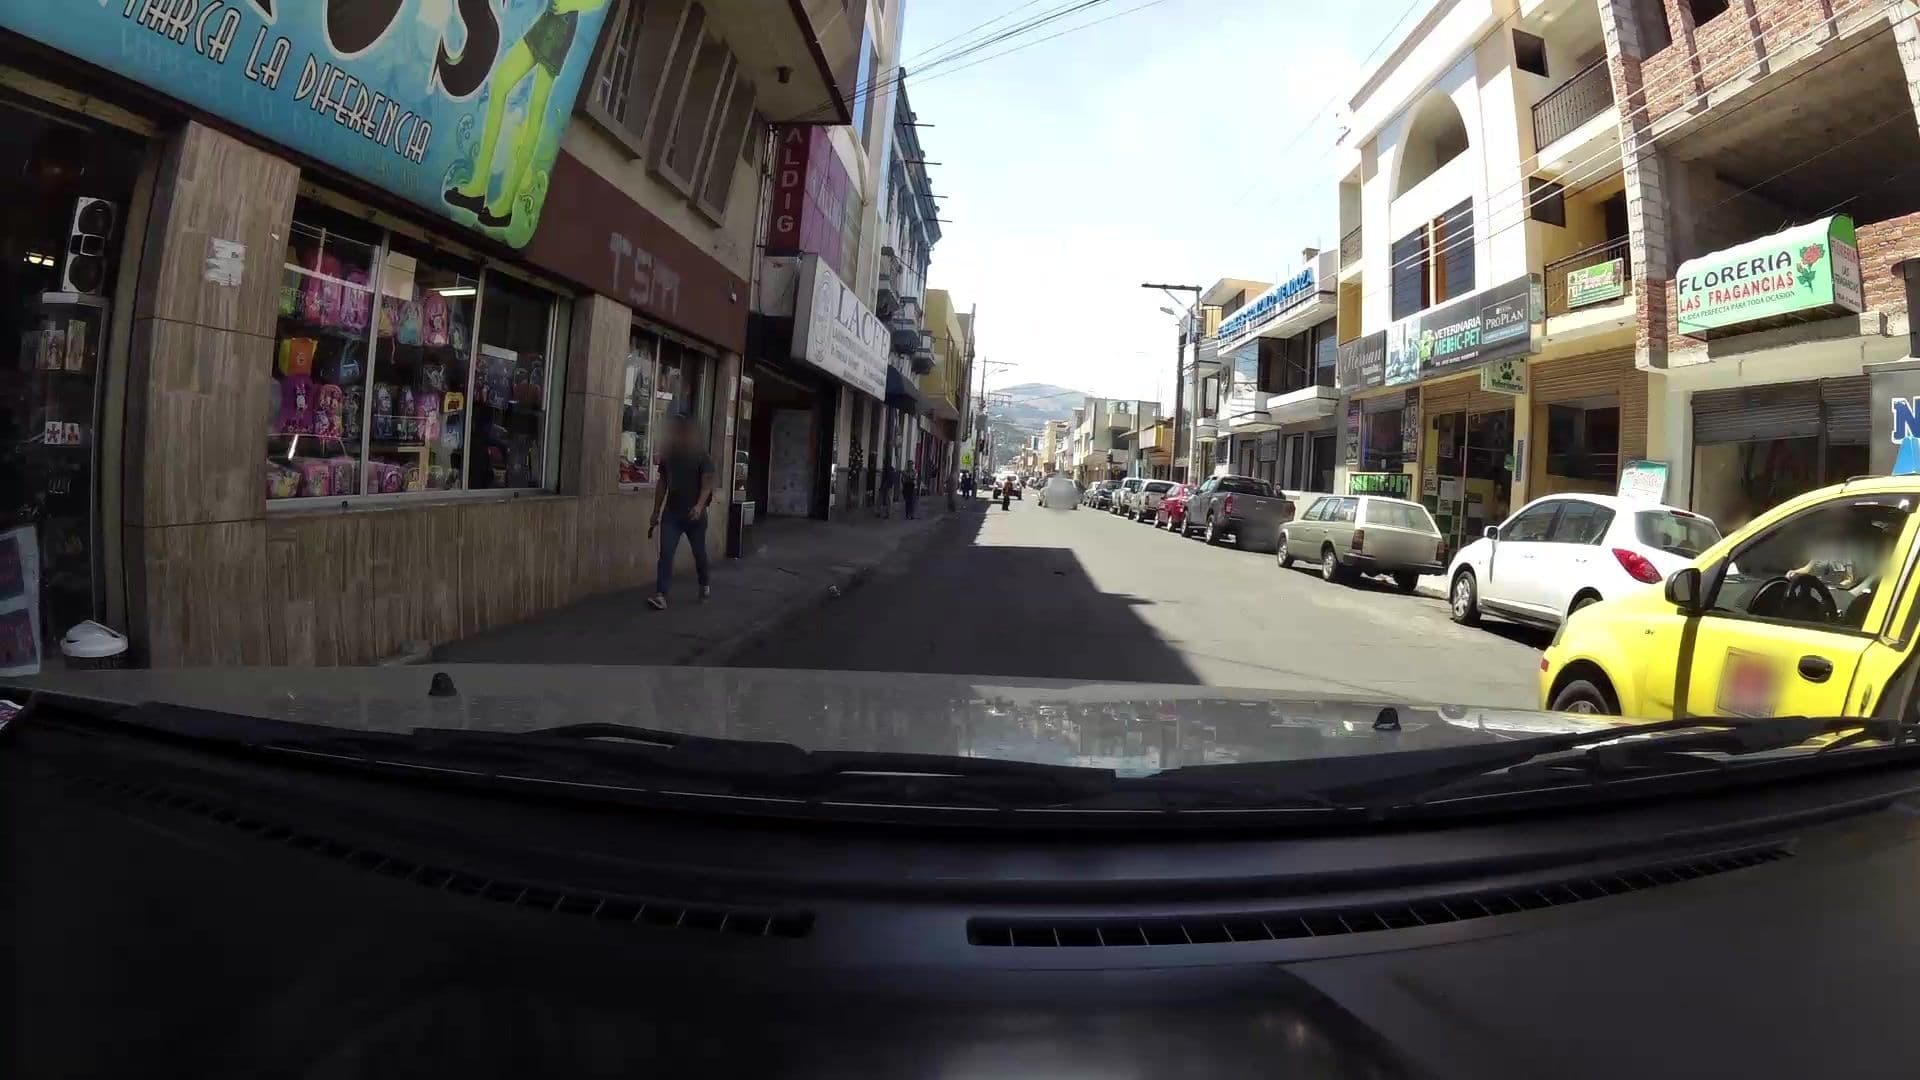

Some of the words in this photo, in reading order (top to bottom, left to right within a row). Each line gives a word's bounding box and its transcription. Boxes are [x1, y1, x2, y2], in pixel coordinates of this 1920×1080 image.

[244, 24, 292, 91] LA
[293, 52, 432, 165] DIFERENCIA
[1679, 251, 1792, 295] FLORERIA
[1679, 295, 1701, 313] LAS
[1709, 270, 1794, 306] FRAGANCIAS
[1434, 315, 1481, 339] VETERINARIA
[1701, 306, 1730, 318] PERFECTA
[1731, 301, 1746, 312] PARA
[1747, 297, 1765, 308] TODA
